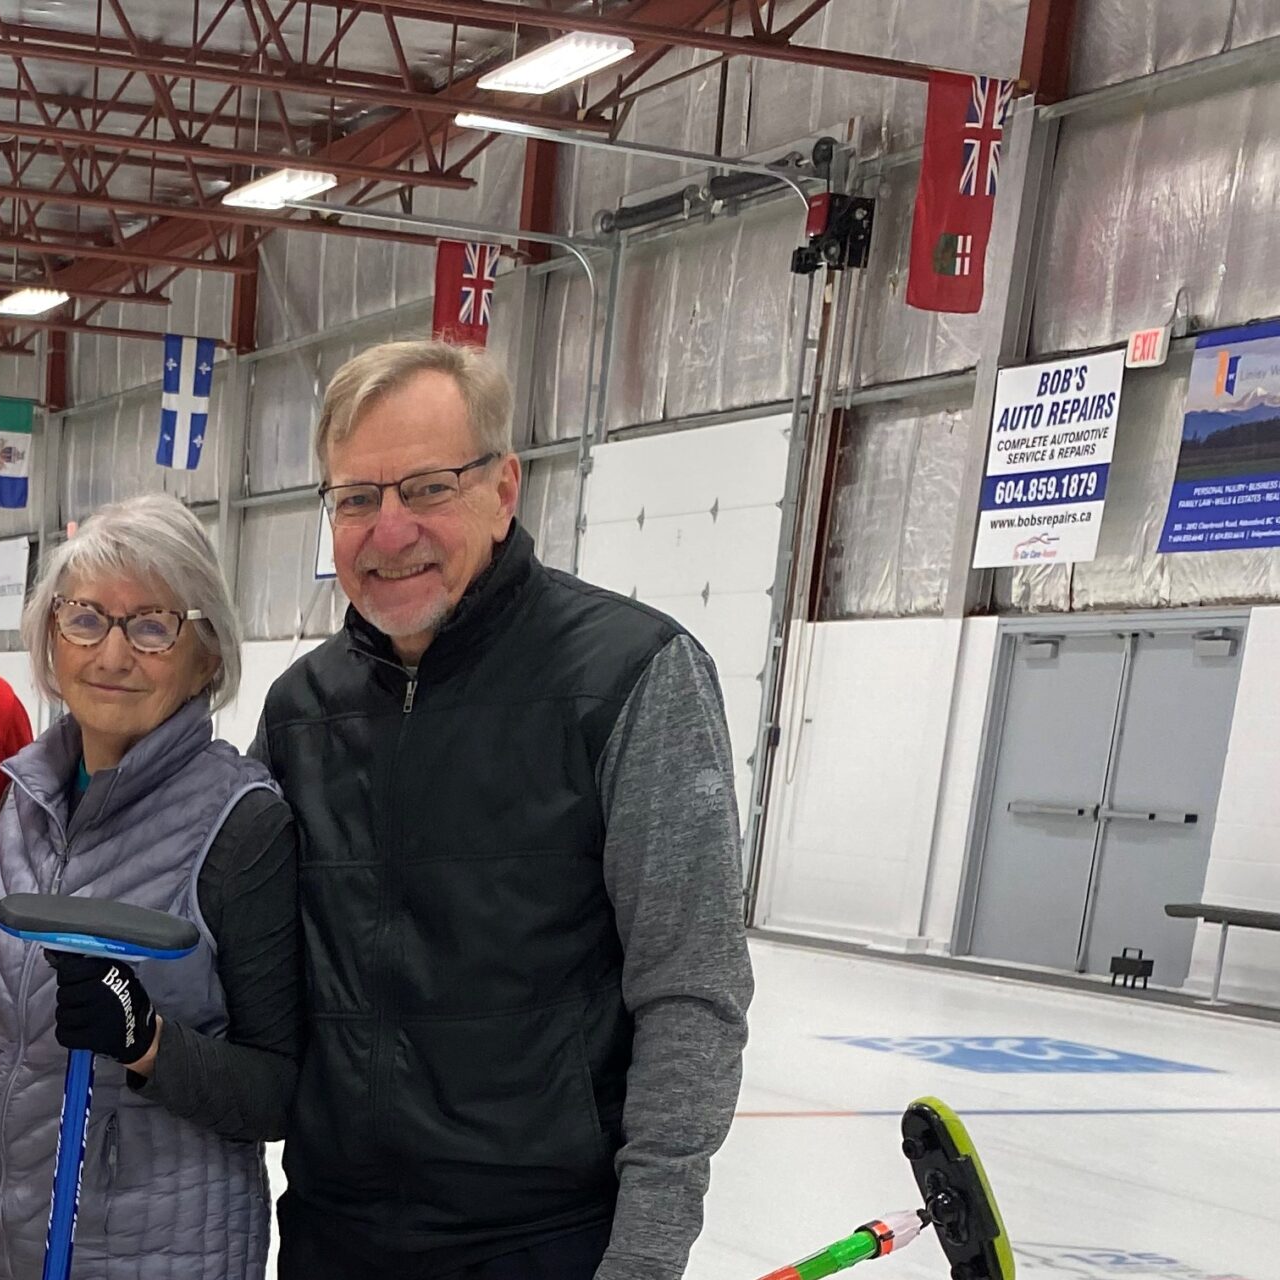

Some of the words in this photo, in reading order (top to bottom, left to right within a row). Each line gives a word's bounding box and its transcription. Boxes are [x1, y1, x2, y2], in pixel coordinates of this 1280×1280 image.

[1131, 331, 1159, 362] EXIT
[1037, 365, 1088, 397] BOB'S
[997, 404, 1042, 433] AUTO
[1046, 392, 1116, 427] REPAIRS
[996, 433, 1047, 452] COMPLETE
[1050, 426, 1109, 446] AUTOMOTIVE
[1006, 449, 1045, 465] SERVICE
[1048, 449, 1055, 460] &
[1057, 443, 1096, 459] REPAIRS
[994, 471, 1098, 505] 604.859.1879
[990, 511, 1091, 530] www.bobsrepairs.ca
[101, 965, 136, 1049] BalancePlus
